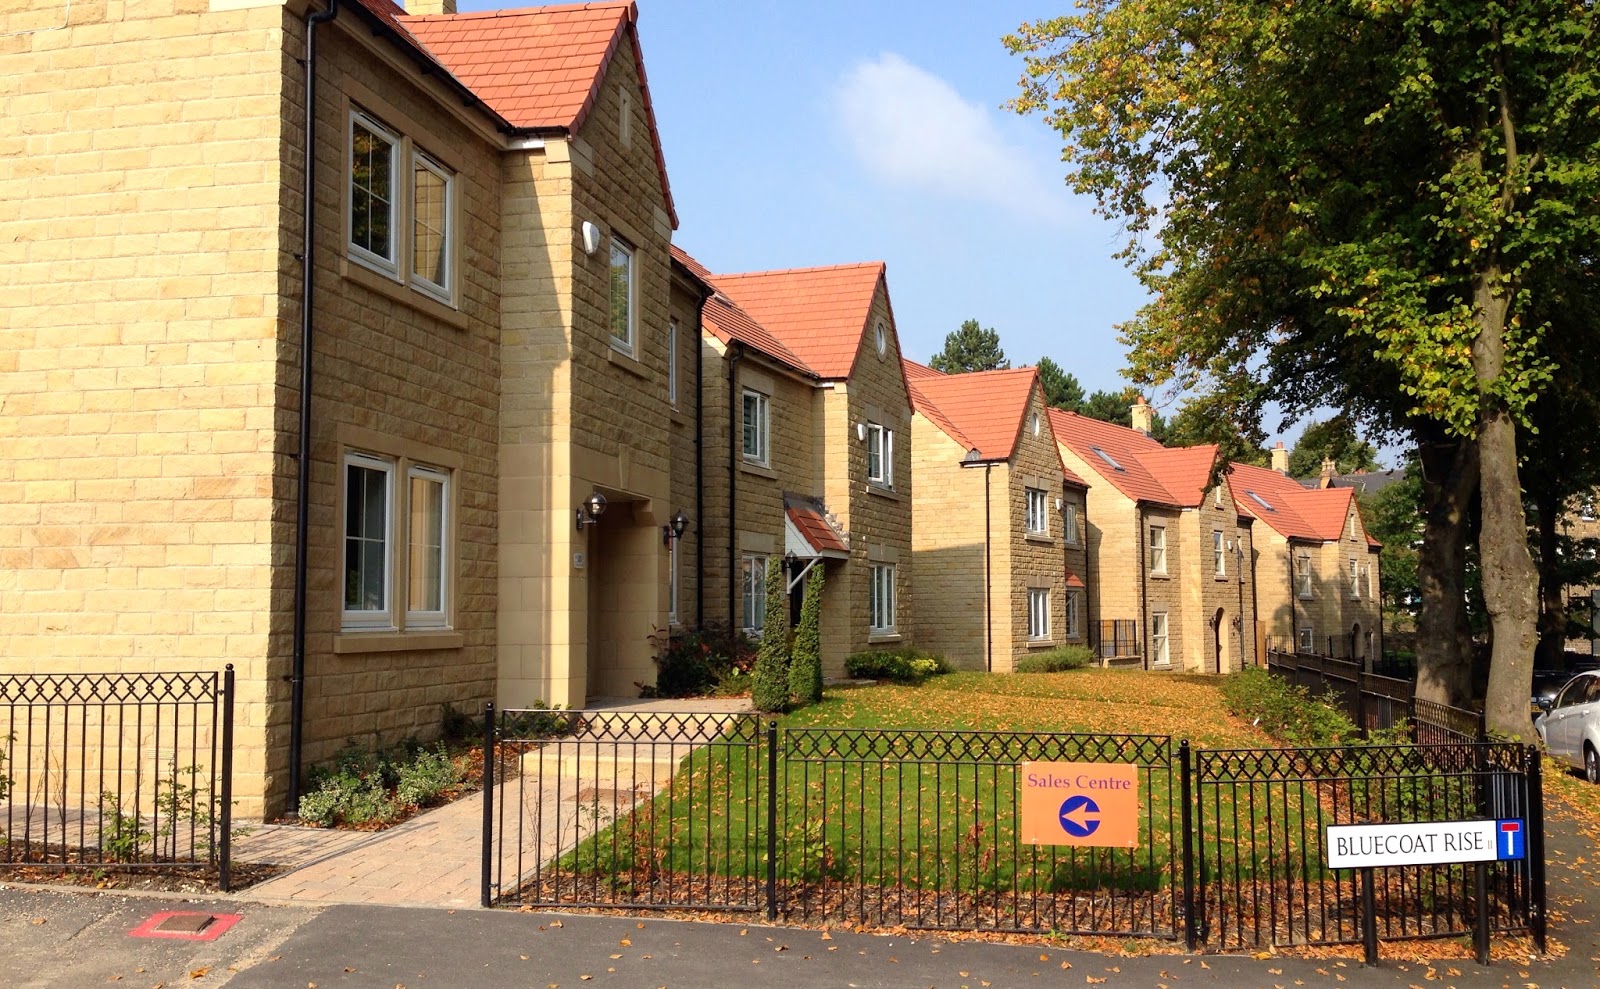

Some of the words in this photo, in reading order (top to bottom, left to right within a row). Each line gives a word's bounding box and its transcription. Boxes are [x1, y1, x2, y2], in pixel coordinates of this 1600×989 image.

[1028, 774, 1070, 788] Sales
[1076, 775, 1131, 790] Centre
[1336, 833, 1438, 857] BLUECOAT
[1444, 831, 1484, 852] RISE
